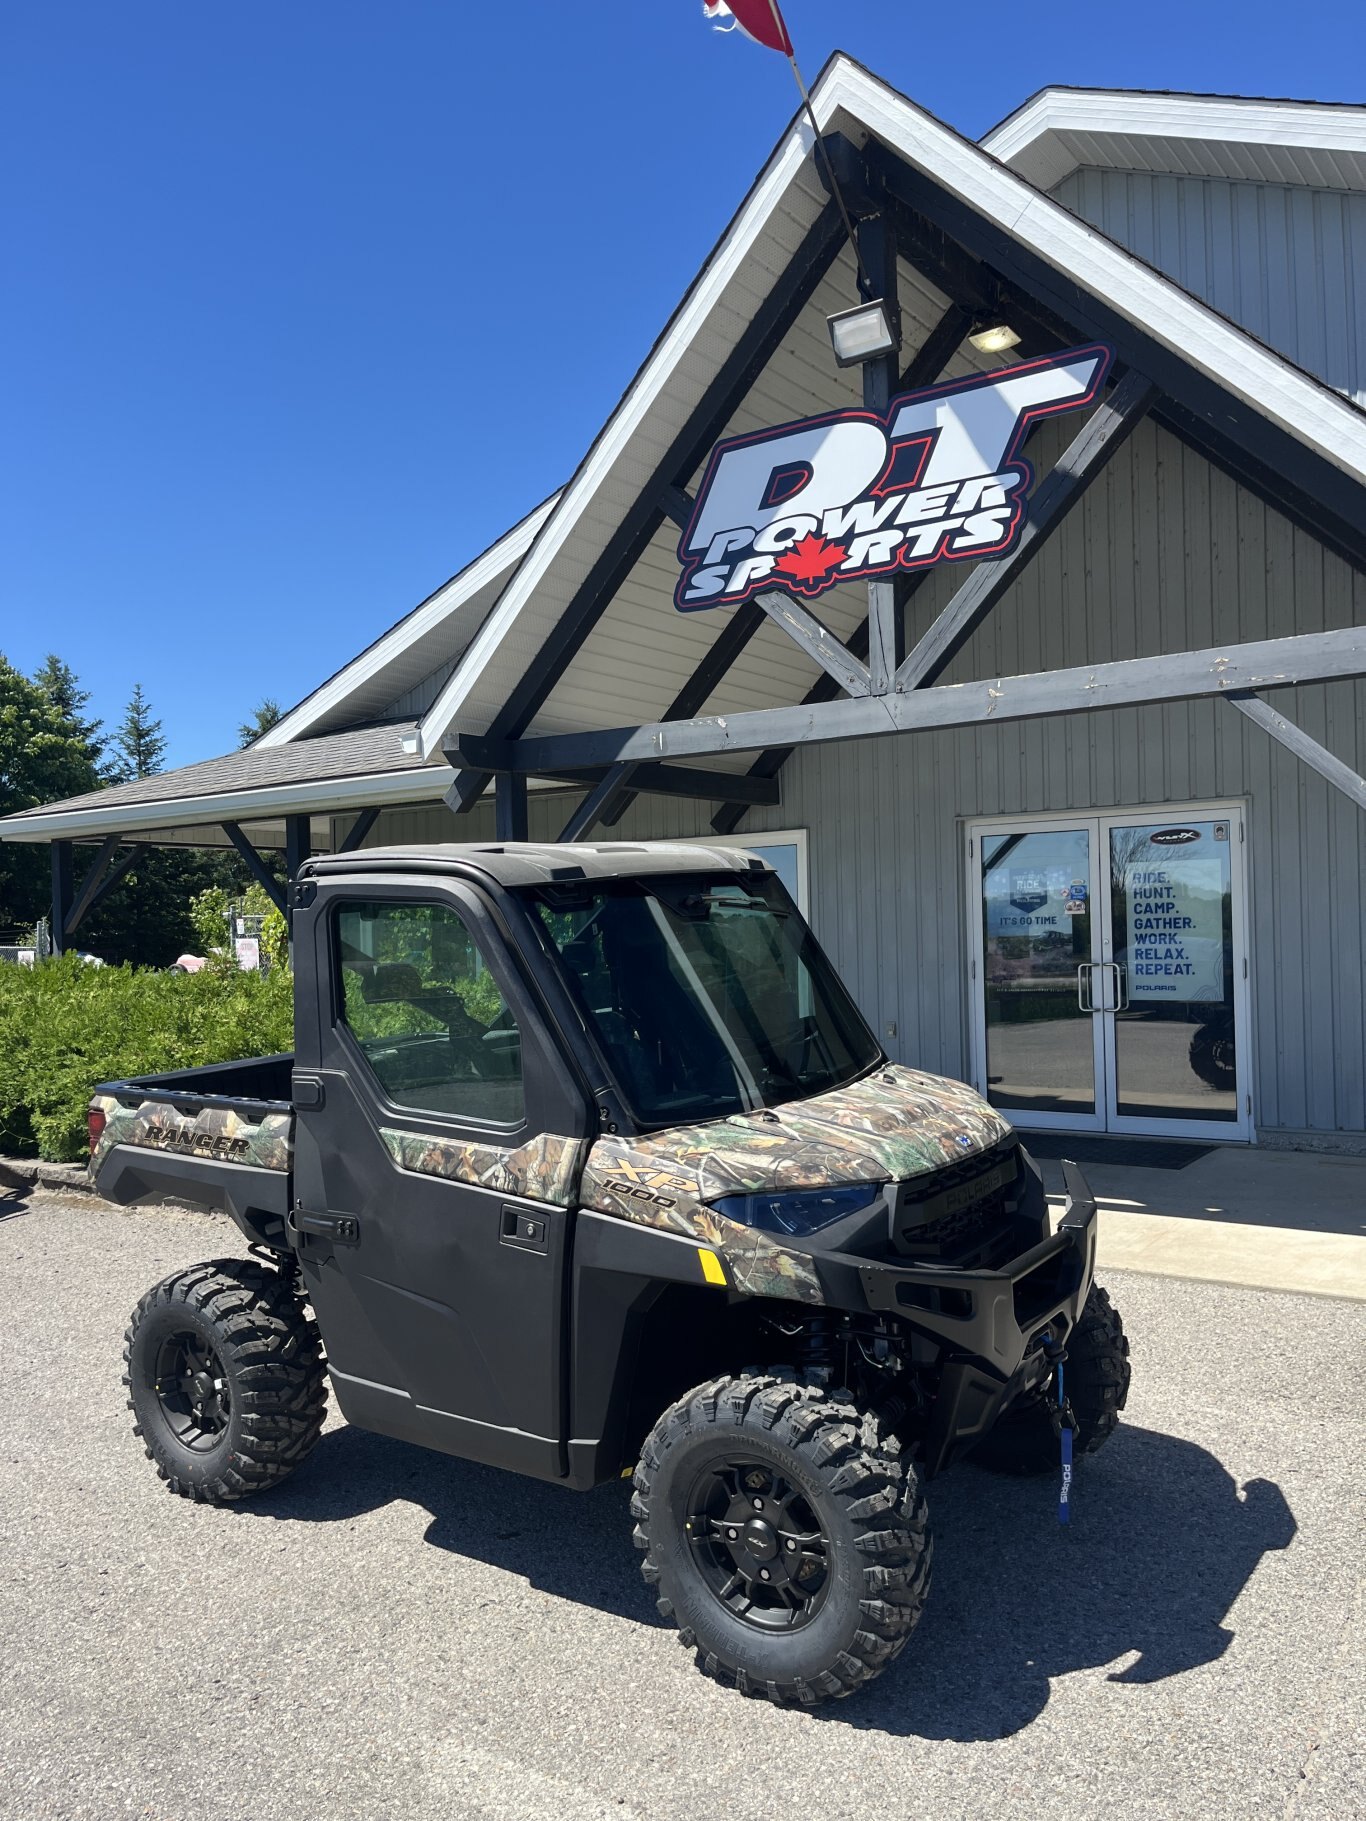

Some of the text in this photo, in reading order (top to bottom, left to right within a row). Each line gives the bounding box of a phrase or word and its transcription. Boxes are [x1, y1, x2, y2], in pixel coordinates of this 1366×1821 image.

[703, 472, 1020, 564] POWER
[685, 508, 1011, 599] SPRTS
[1132, 872, 1170, 884] RIDE.
[1133, 887, 1176, 899] HUNT.
[1133, 902, 1179, 914] CAMP.
[1000, 916, 1057, 926] IT'S GO TIME
[1134, 917, 1196, 929] GATHER.
[1134, 932, 1182, 944] WORK.
[1135, 948, 1189, 960] RELAX.
[1135, 963, 1195, 975] REPEAT.
[144, 1125, 250, 1155] RANGER
[595, 1157, 701, 1192] XP
[602, 1179, 677, 1209] 1000
[1060, 1464, 1071, 1504] POLARIS
